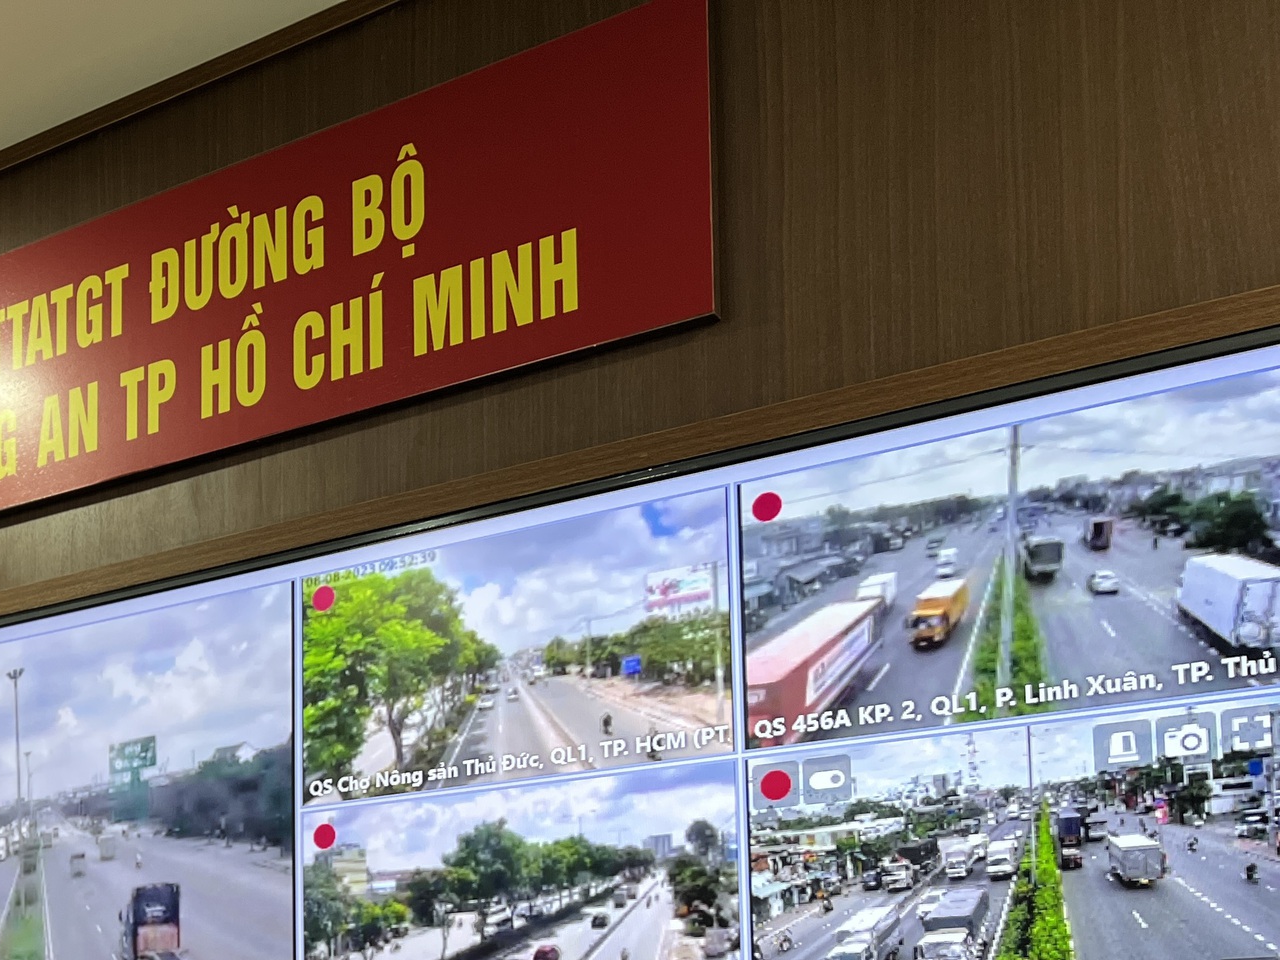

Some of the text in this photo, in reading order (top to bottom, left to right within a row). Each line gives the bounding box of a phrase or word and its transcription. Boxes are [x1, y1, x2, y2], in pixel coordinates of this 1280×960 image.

[149, 195, 324, 324] ĐƯỜNG
[352, 142, 425, 258] BỘ
[37, 381, 98, 467] AN
[120, 359, 176, 441] TP
[201, 302, 266, 419] HỒ
[293, 272, 385, 390] CHÍ
[412, 227, 578, 357] MINH
[754, 650, 1277, 739] QS 456A KP. 2, QL1, P. Linh Xuân, TP. Thủ
[308, 732, 686, 797] QS Chợ Nông sản Thủ Đức, QL1, TP. HCM
